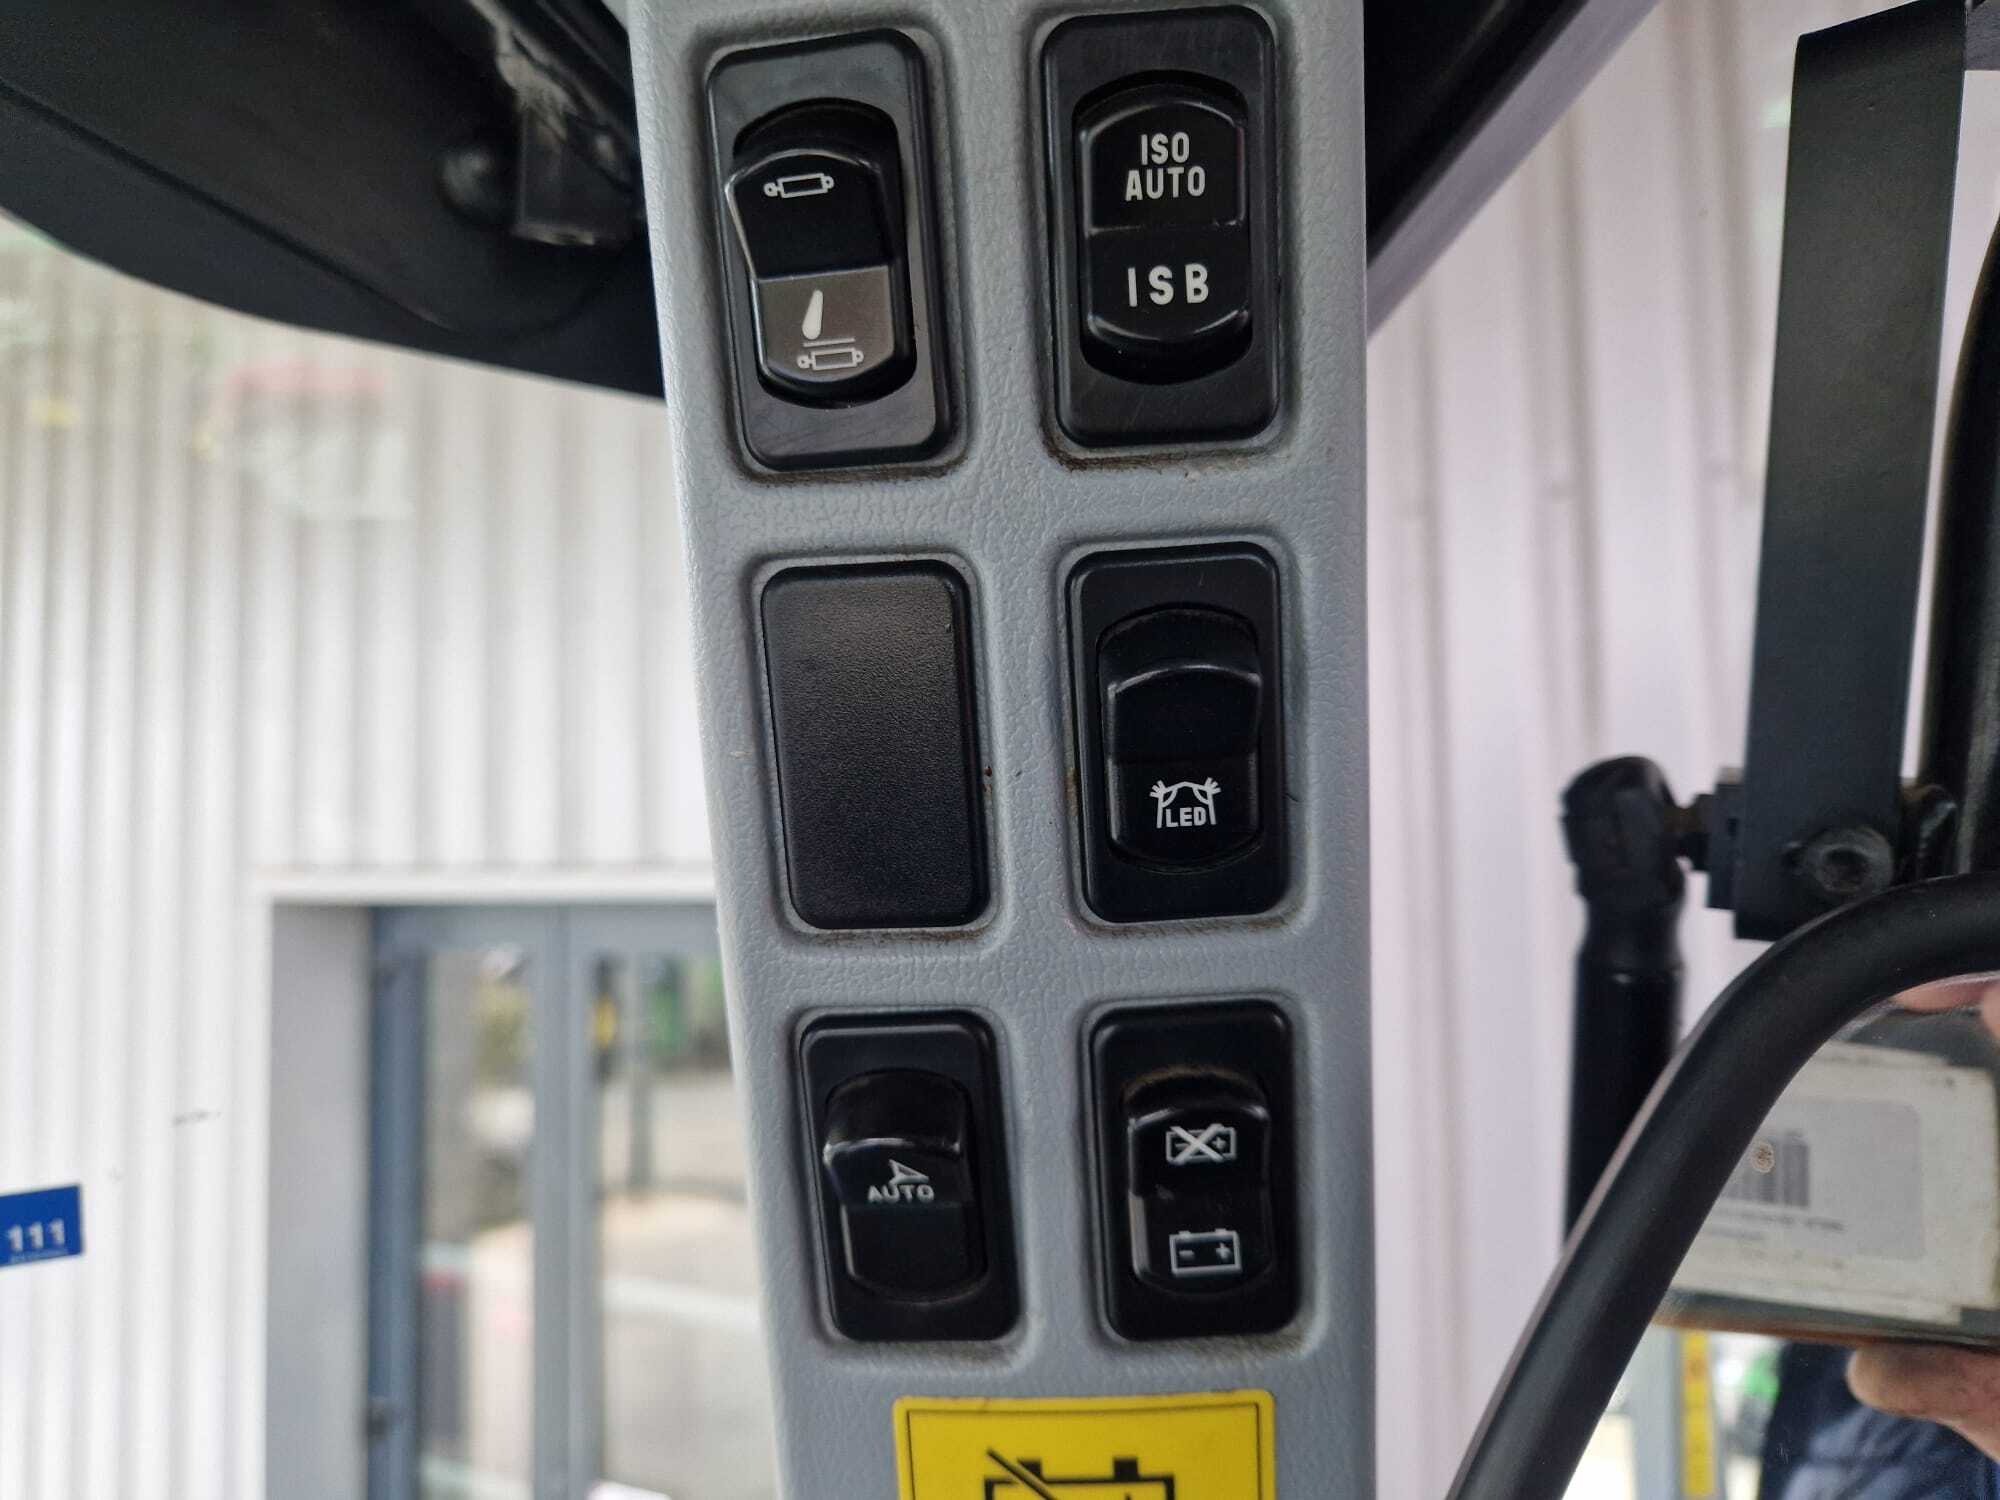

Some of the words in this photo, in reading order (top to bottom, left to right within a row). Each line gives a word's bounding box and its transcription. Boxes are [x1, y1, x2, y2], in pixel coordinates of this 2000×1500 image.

[1140, 131, 1190, 166] ISO
[1125, 165, 1206, 201] AUTO
[1165, 806, 1207, 828] LED
[867, 1183, 935, 1203] AUTO
[9, 1217, 66, 1253] 111
